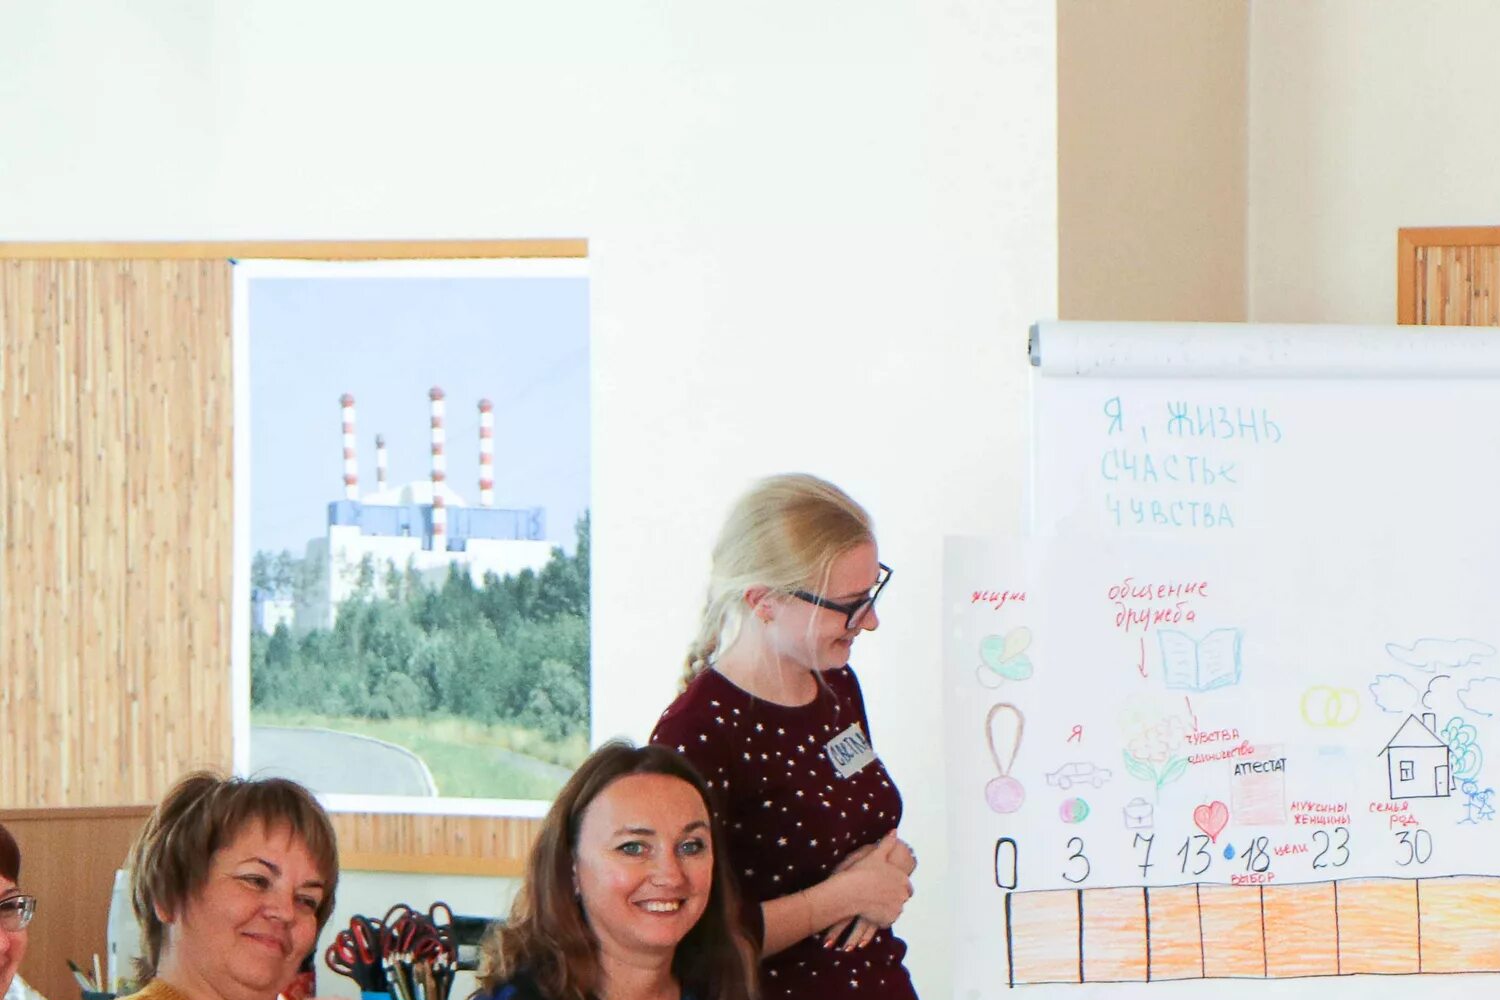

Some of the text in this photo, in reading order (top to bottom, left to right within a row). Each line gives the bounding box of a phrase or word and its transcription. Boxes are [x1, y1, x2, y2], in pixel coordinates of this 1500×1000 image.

[1167, 401, 1282, 443] ЖИЗНЬ
[1105, 494, 1235, 528] ЧУВСТВА
[1067, 724, 1083, 742] Я
[994, 836, 1018, 890] 0
[1062, 836, 1091, 884] 3
[1132, 833, 1155, 878] 7
[1177, 834, 1212, 876] 13
[1240, 836, 1270, 873] 18
[1312, 826, 1350, 869] 23
[1394, 829, 1433, 867] 30
